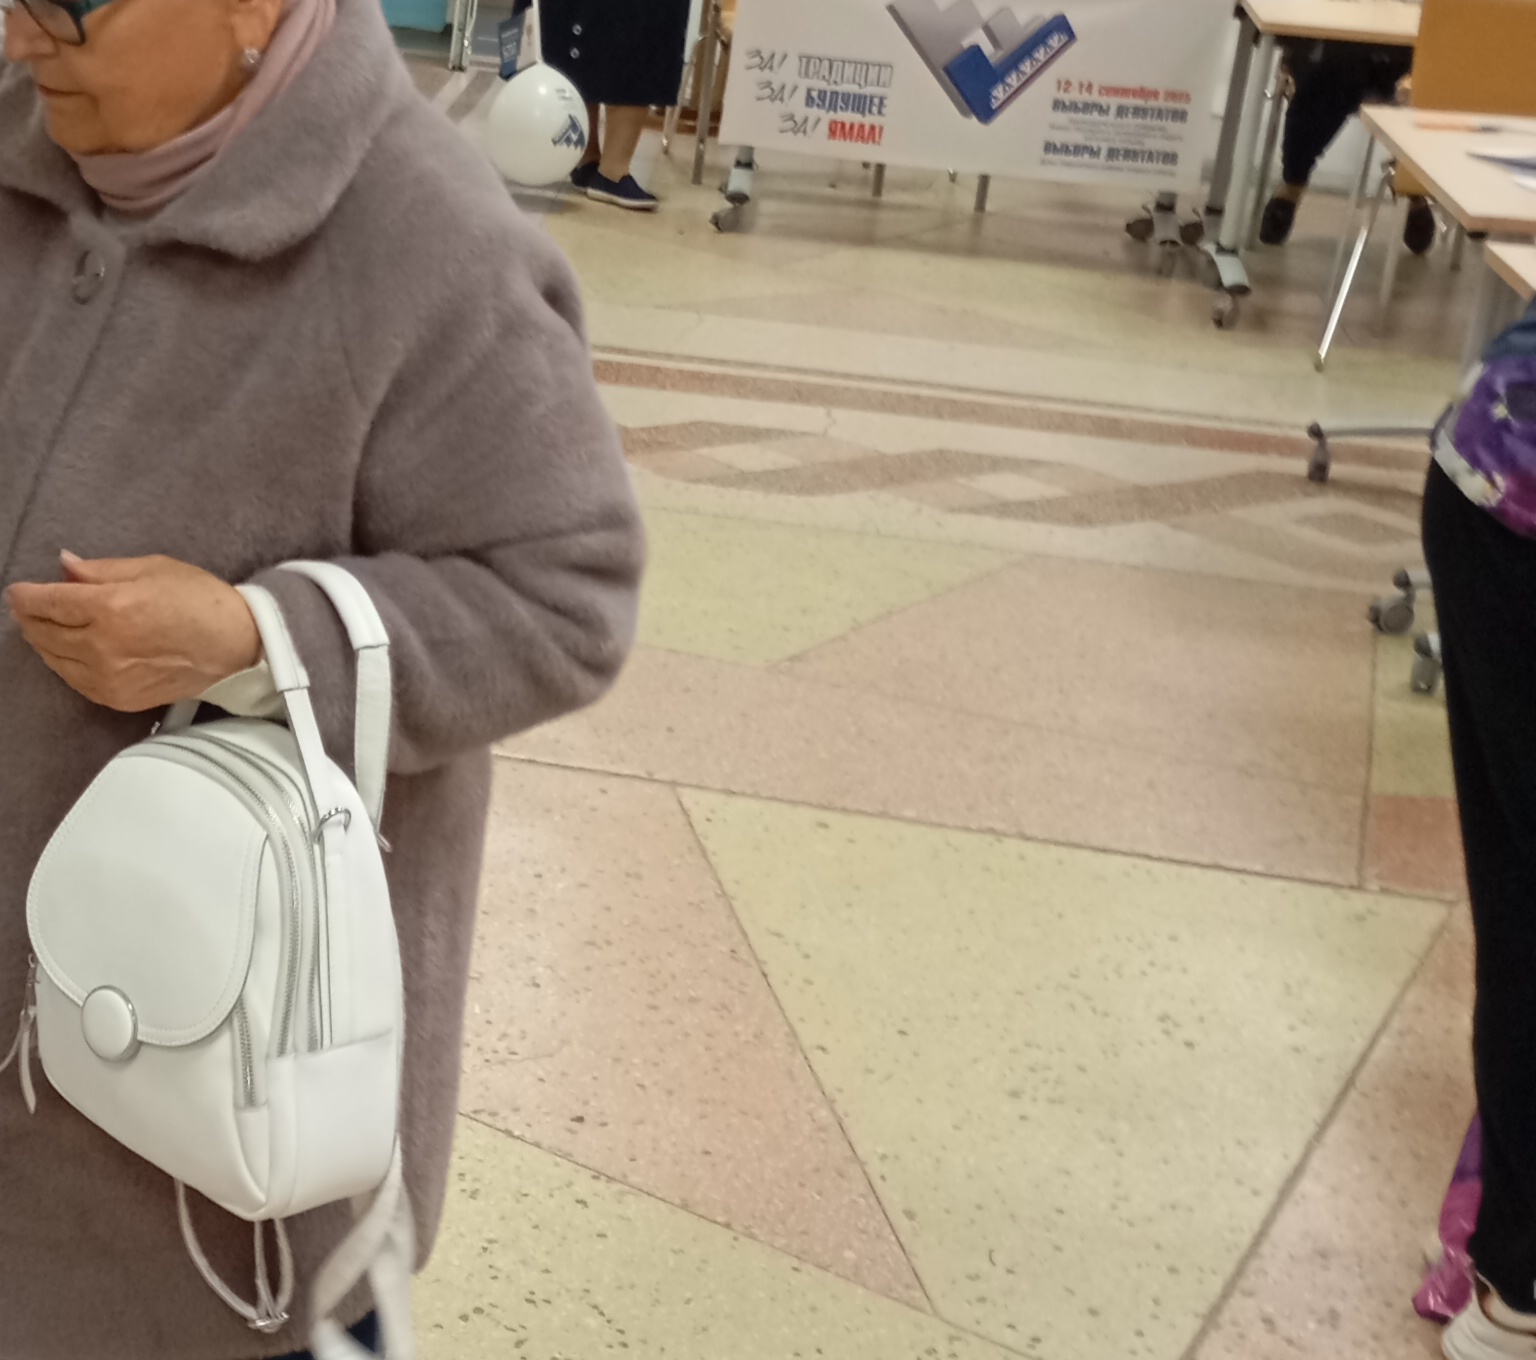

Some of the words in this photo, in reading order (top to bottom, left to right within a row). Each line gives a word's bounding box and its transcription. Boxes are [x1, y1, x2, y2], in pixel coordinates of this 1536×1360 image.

[745, 48, 787, 74] ЗА!
[798, 55, 893, 89] ТРАДИЦИИ
[756, 79, 798, 106] ЗА!
[804, 87, 887, 118] БУДУЩЕЕ
[1051, 97, 1111, 117] ВЫБОРЫ
[1114, 104, 1188, 125] ДЕПУТАТОВ
[779, 112, 821, 139] ЗА!
[827, 118, 884, 146] ЯМАЛ!
[1043, 140, 1102, 160] ВЫБОРЫ
[1105, 146, 1179, 167] ДЕПУТАТОВ
